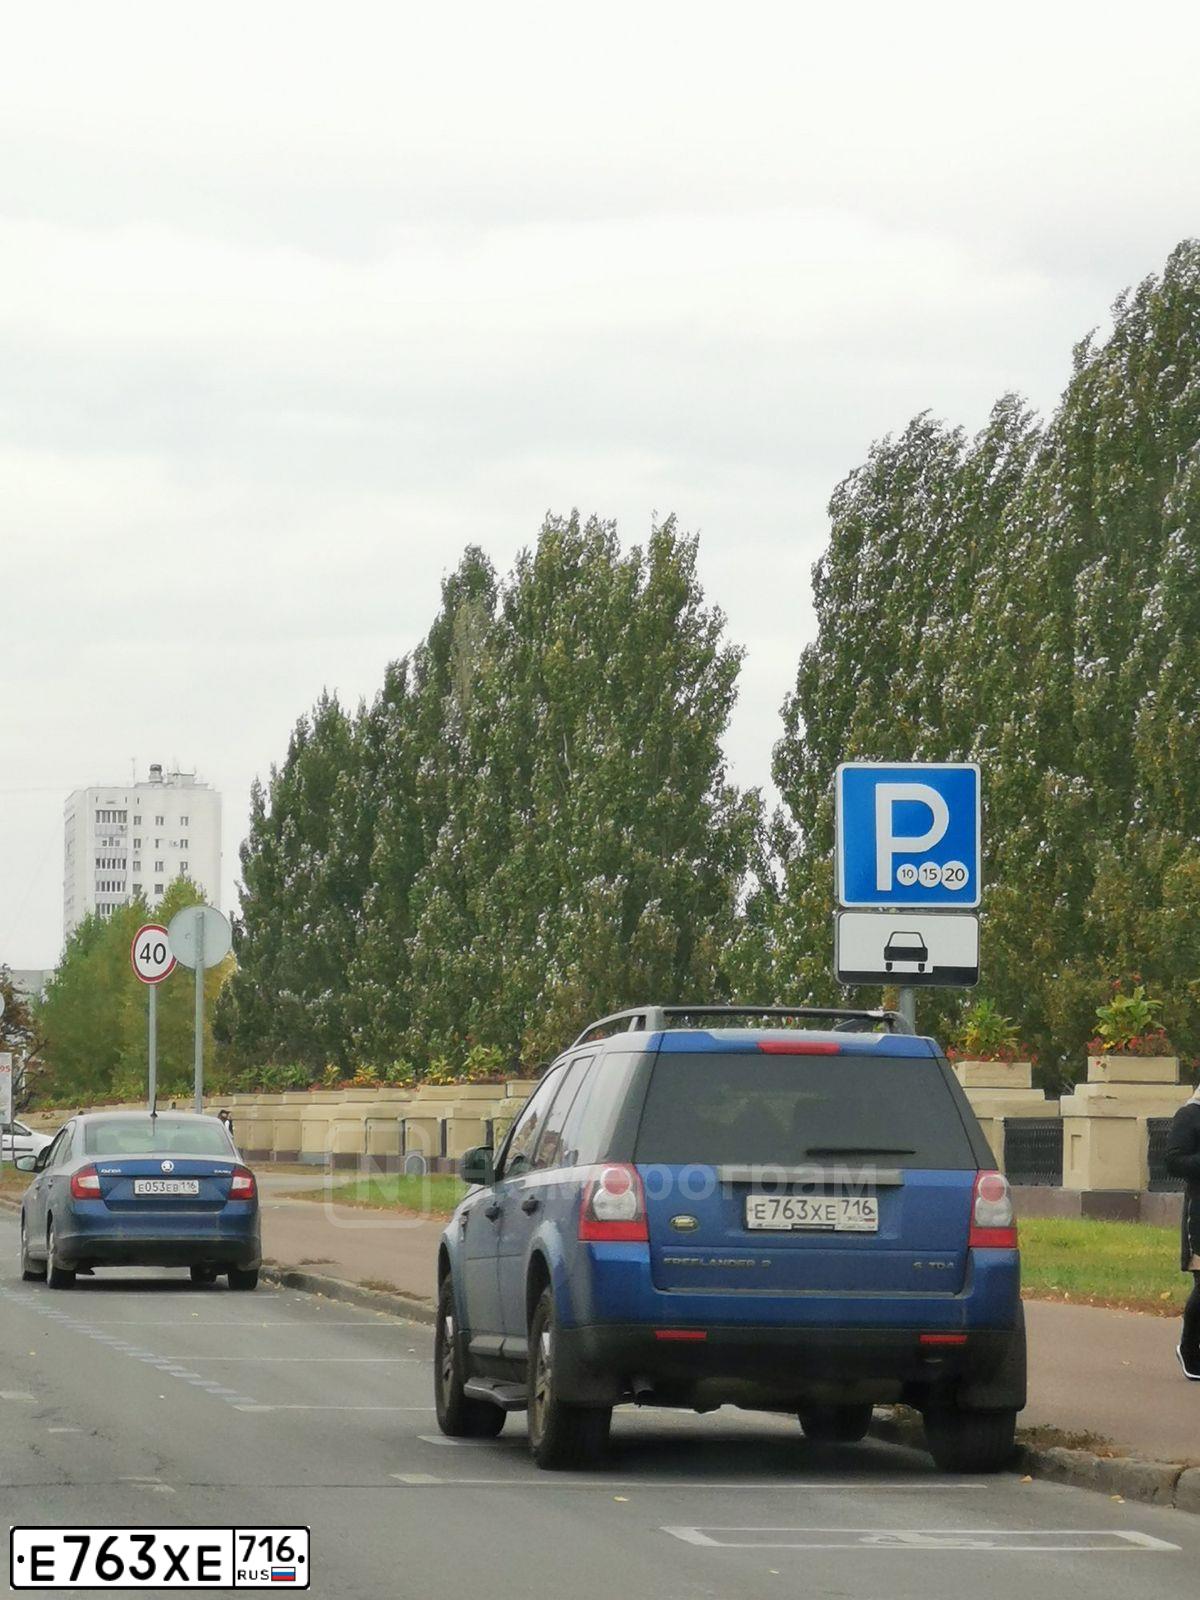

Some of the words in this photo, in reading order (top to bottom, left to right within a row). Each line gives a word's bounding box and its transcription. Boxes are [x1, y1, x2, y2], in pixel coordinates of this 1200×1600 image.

[875, 783, 950, 891] P
[902, 869, 914, 879] 10
[923, 868, 938, 881] 15
[945, 868, 965, 882] 20
[139, 942, 167, 965] 40
[840, 1200, 875, 1216] 716
